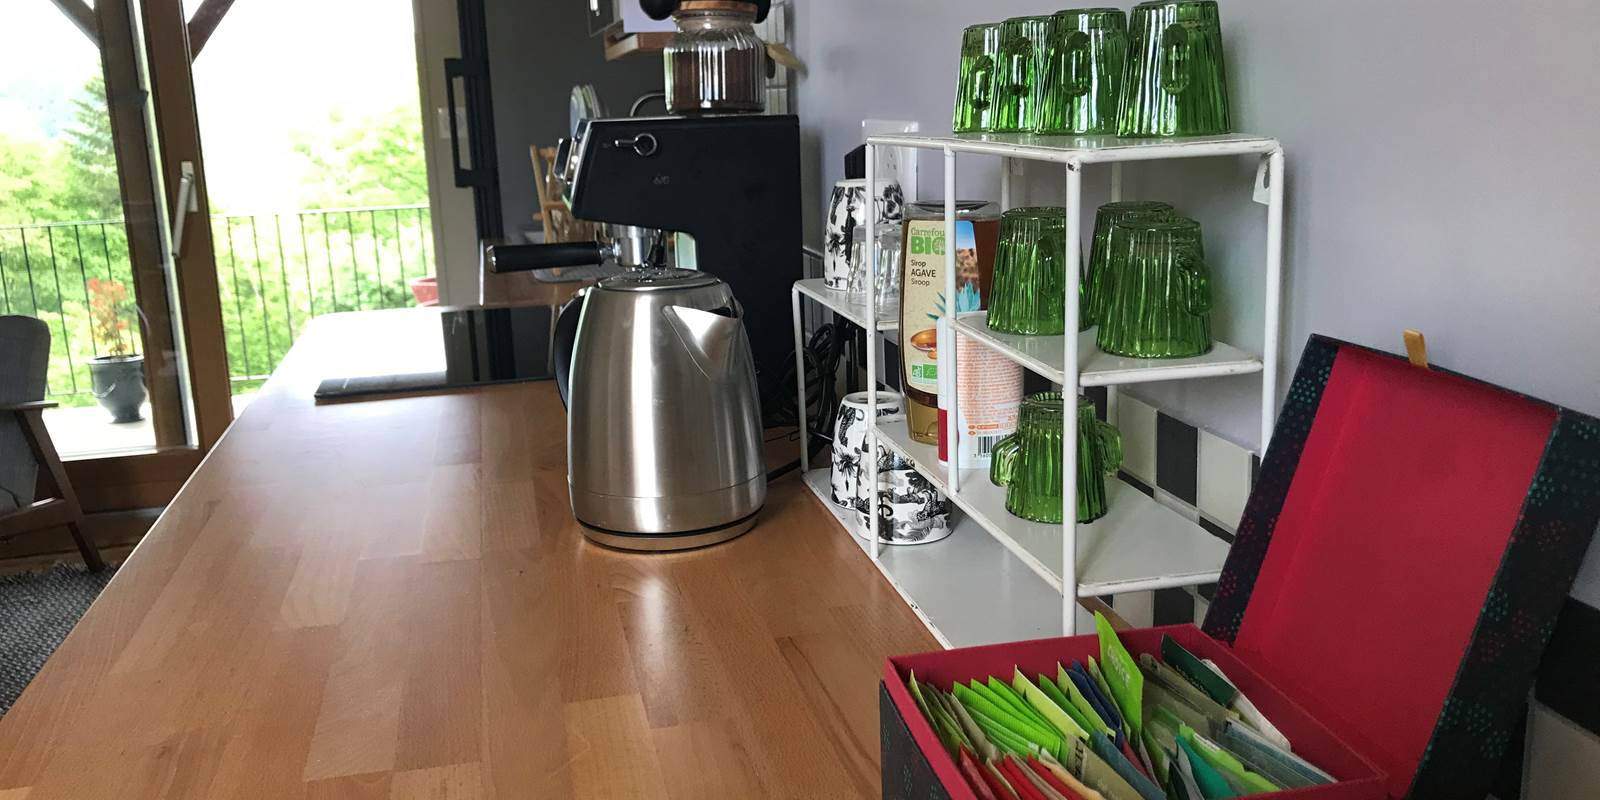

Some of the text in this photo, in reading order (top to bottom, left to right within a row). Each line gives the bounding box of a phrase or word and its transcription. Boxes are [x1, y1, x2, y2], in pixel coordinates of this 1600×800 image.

[911, 227, 945, 236] Carrefou
[911, 259, 927, 268] Sirop
[911, 269, 937, 278] AGAVE
[911, 278, 930, 287] Siroop
